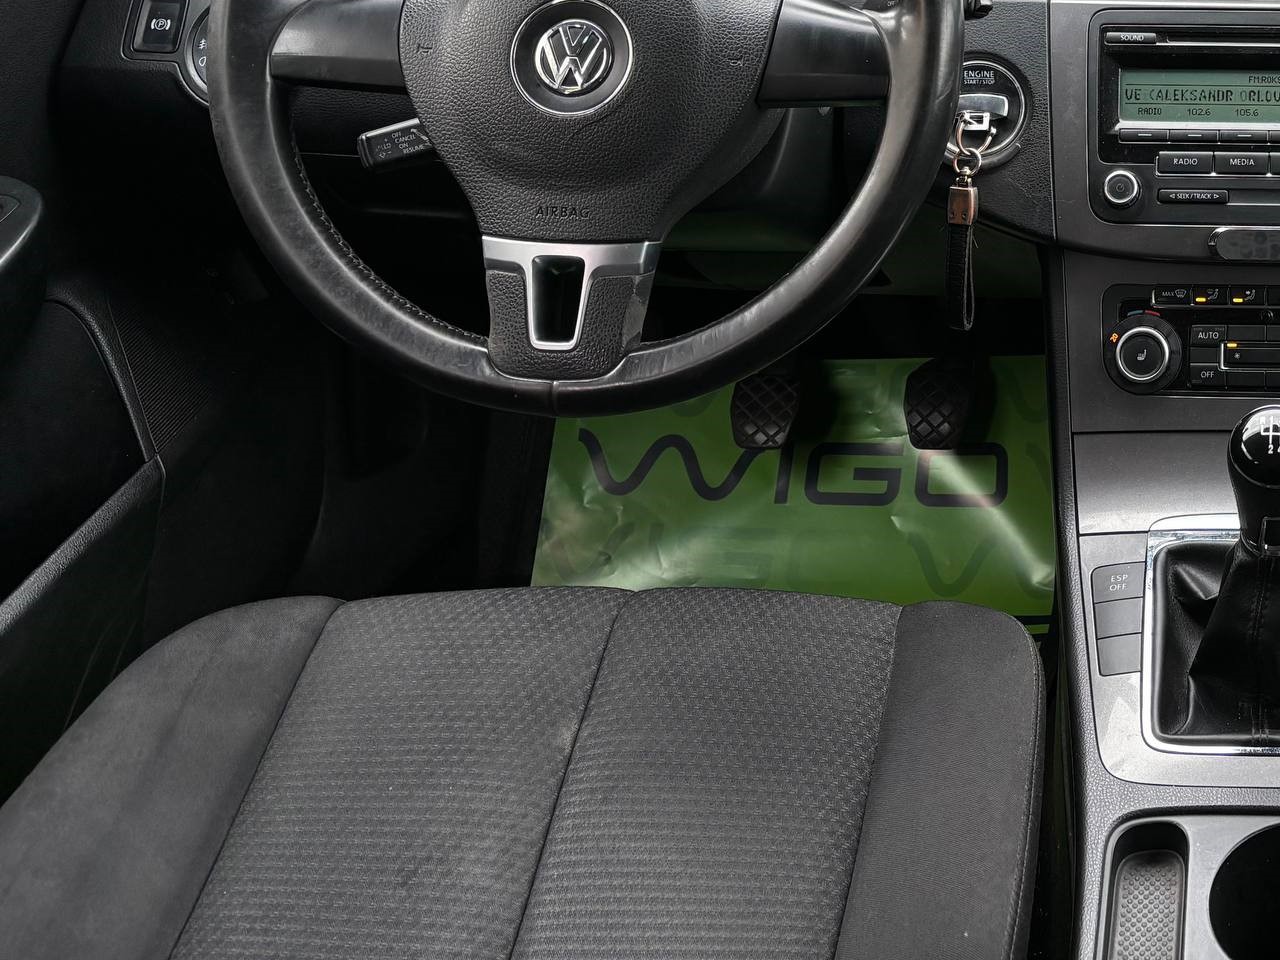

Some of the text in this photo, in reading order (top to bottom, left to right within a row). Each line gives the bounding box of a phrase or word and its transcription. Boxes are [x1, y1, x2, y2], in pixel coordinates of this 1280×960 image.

[964, 70, 995, 78] ENGINE
[1137, 107, 1162, 116] RADIO
[1187, 108, 1211, 116] 102.6
[1235, 109, 1259, 117] 105.6
[1173, 157, 1198, 166] RADIO
[1230, 158, 1255, 166] MEDIA
[535, 206, 590, 219] AIRBAG
[1109, 333, 1119, 343] 20
[1268, 444, 1274, 454] 2
[578, 427, 1009, 508] WIGO
[1110, 574, 1128, 583] ESP
[1109, 582, 1127, 591] OFF
